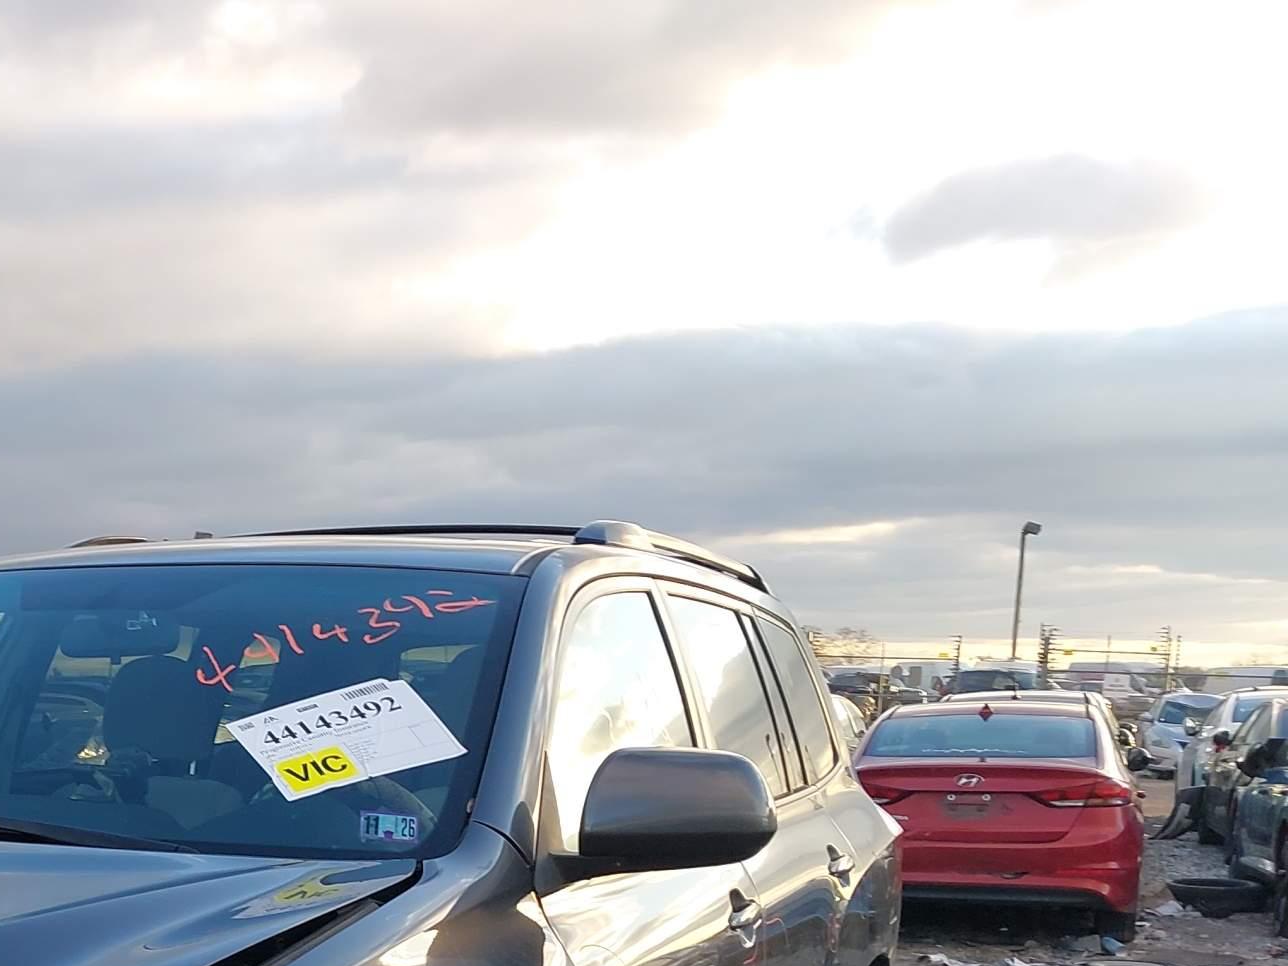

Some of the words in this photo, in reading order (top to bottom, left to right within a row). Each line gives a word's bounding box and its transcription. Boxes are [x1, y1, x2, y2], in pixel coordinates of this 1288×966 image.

[264, 697, 402, 744] 44143492
[283, 755, 348, 782] VIC
[401, 817, 415, 838] 26
